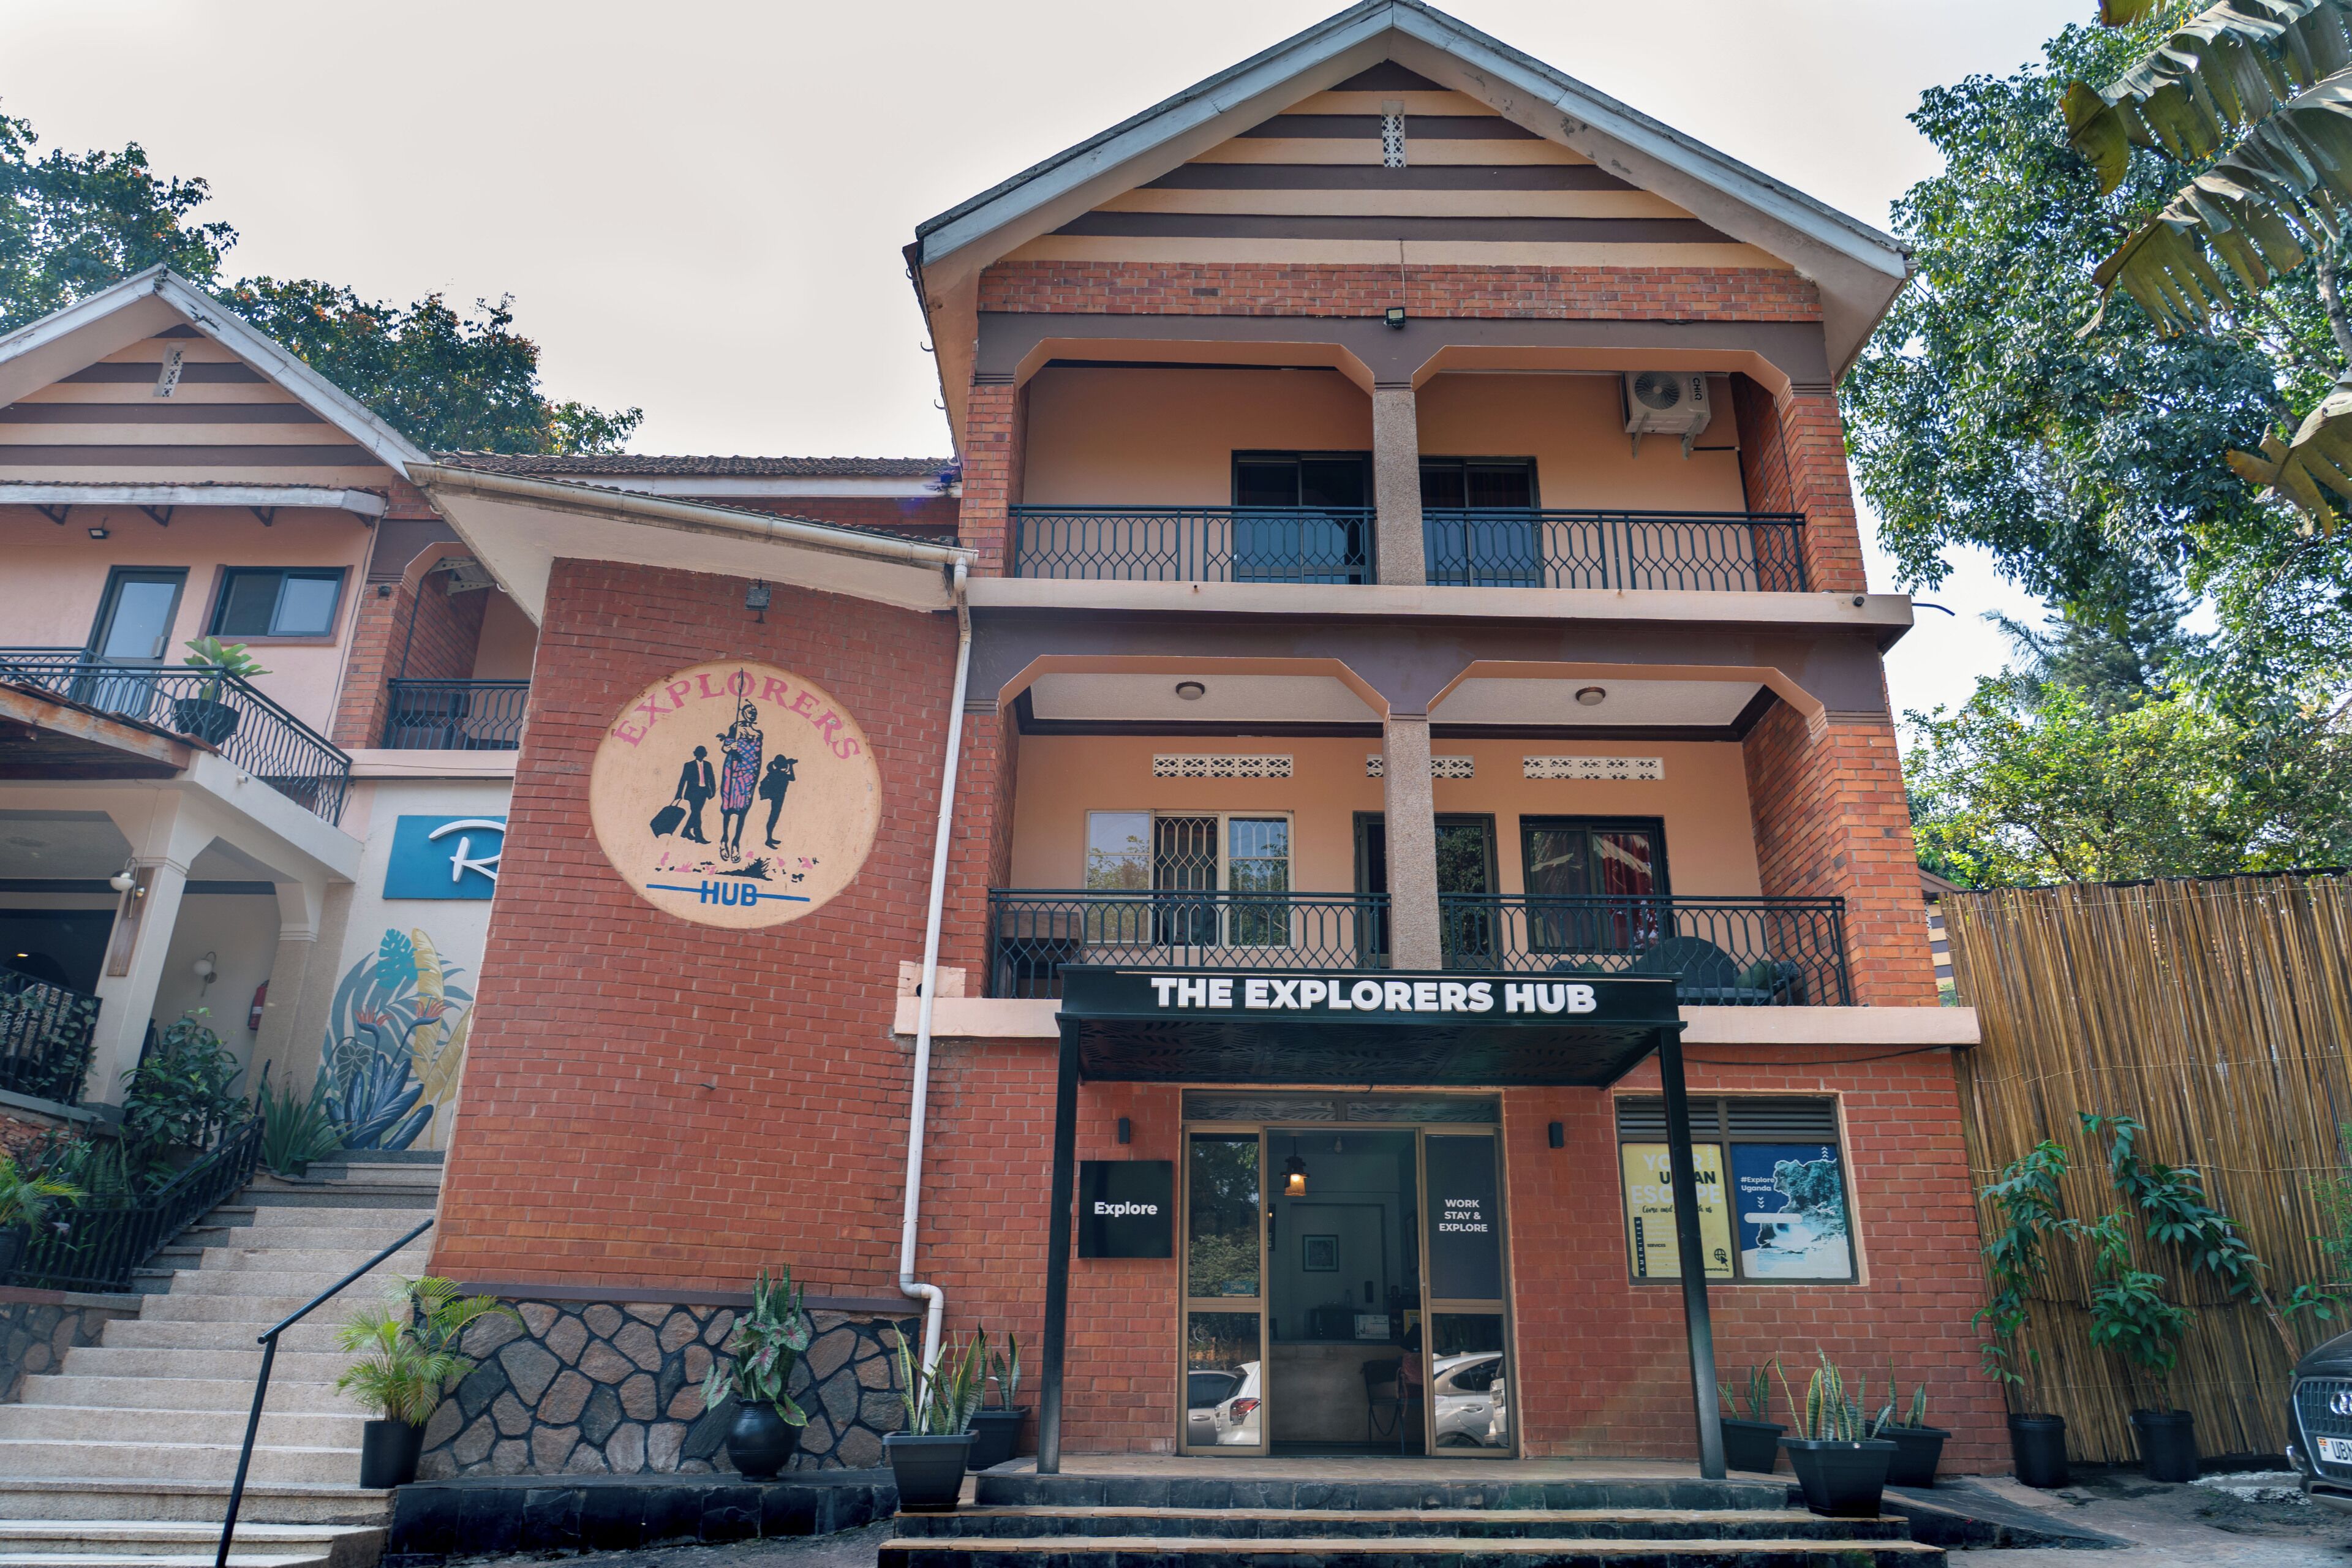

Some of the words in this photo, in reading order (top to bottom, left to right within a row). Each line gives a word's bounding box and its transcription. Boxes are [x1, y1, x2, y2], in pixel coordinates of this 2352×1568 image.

[612, 671, 861, 760] EXPLORERS
[700, 880, 758, 907] HUB
[1151, 978, 1233, 1008] THE
[1245, 980, 1493, 1012] EXPLORERS
[1505, 984, 1597, 1014] HUB
[1643, 1153, 1702, 1171] YOR
[1659, 1171, 1716, 1185] UAN
[1445, 1199, 1480, 1208] WORK
[1630, 1185, 1722, 1204] ESCPE
[1094, 1201, 1158, 1218] Explore
[1473, 1212, 1481, 1220] &
[1439, 1223, 1488, 1232] EXPLORE
[1635, 1220, 1645, 1272] AMENITIES
